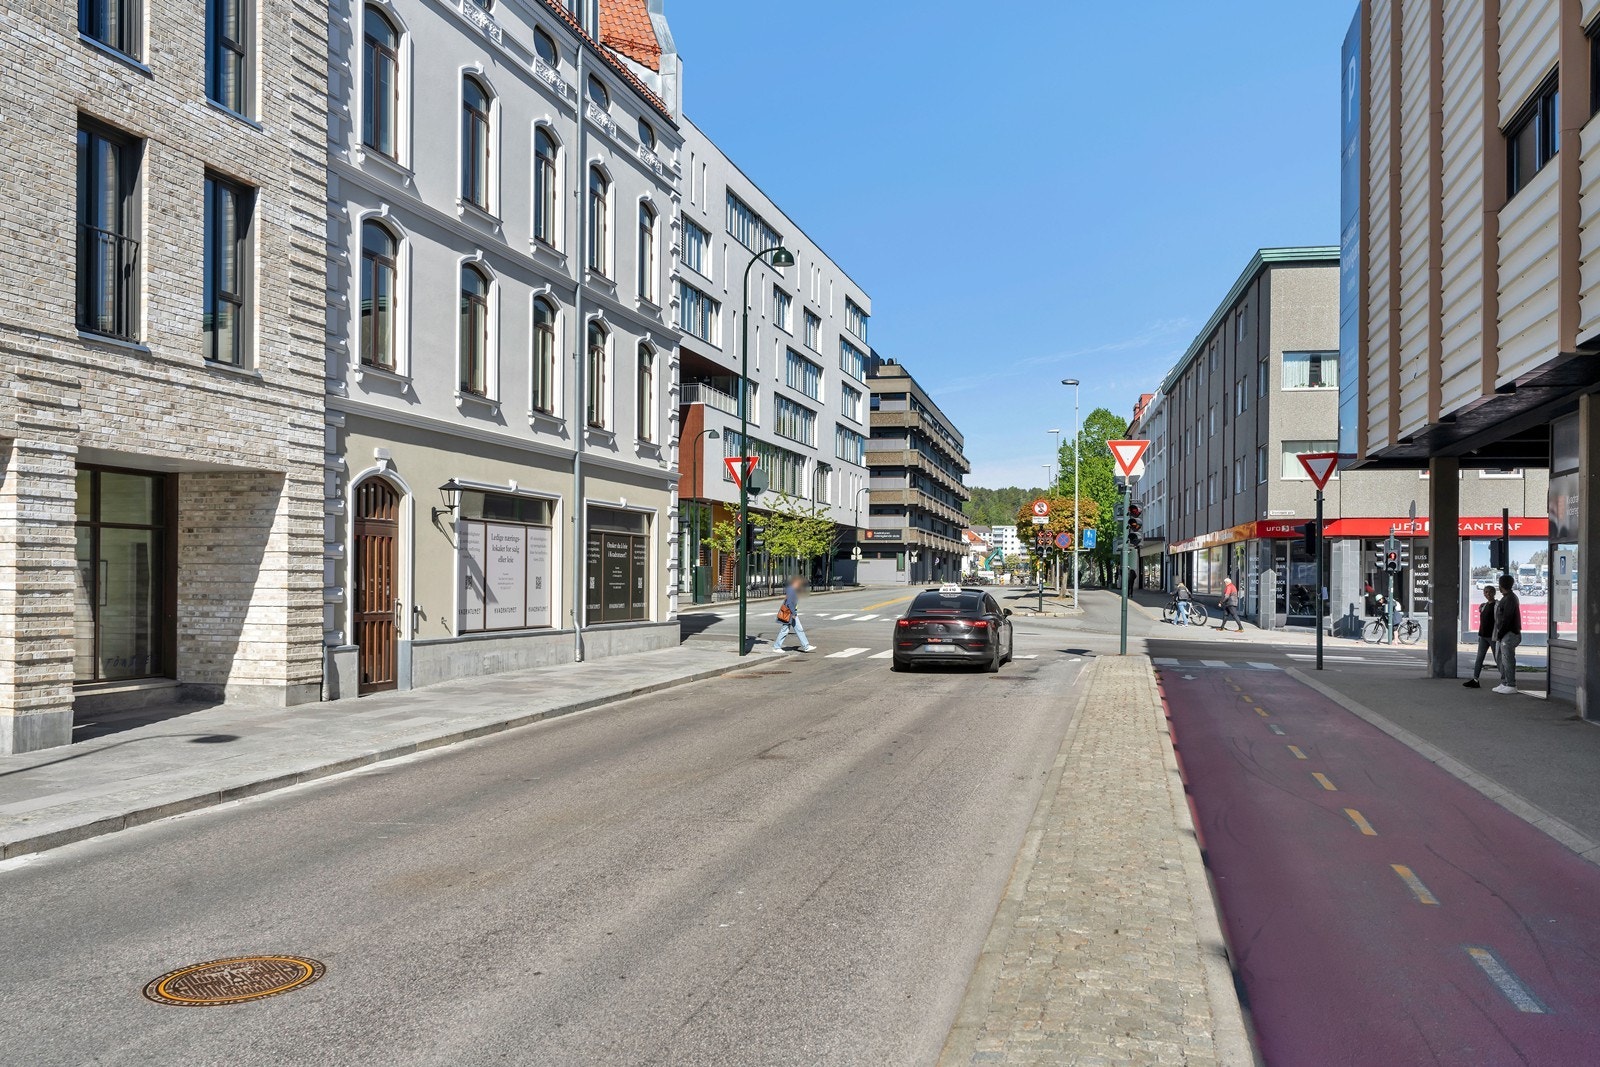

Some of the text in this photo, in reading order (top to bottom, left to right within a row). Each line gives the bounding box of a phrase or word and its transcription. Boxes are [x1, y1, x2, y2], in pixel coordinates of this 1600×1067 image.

[1348, 55, 1356, 122] P
[491, 533, 504, 542] Ledige
[491, 544, 505, 552] lokaler
[512, 546, 520, 554] salg
